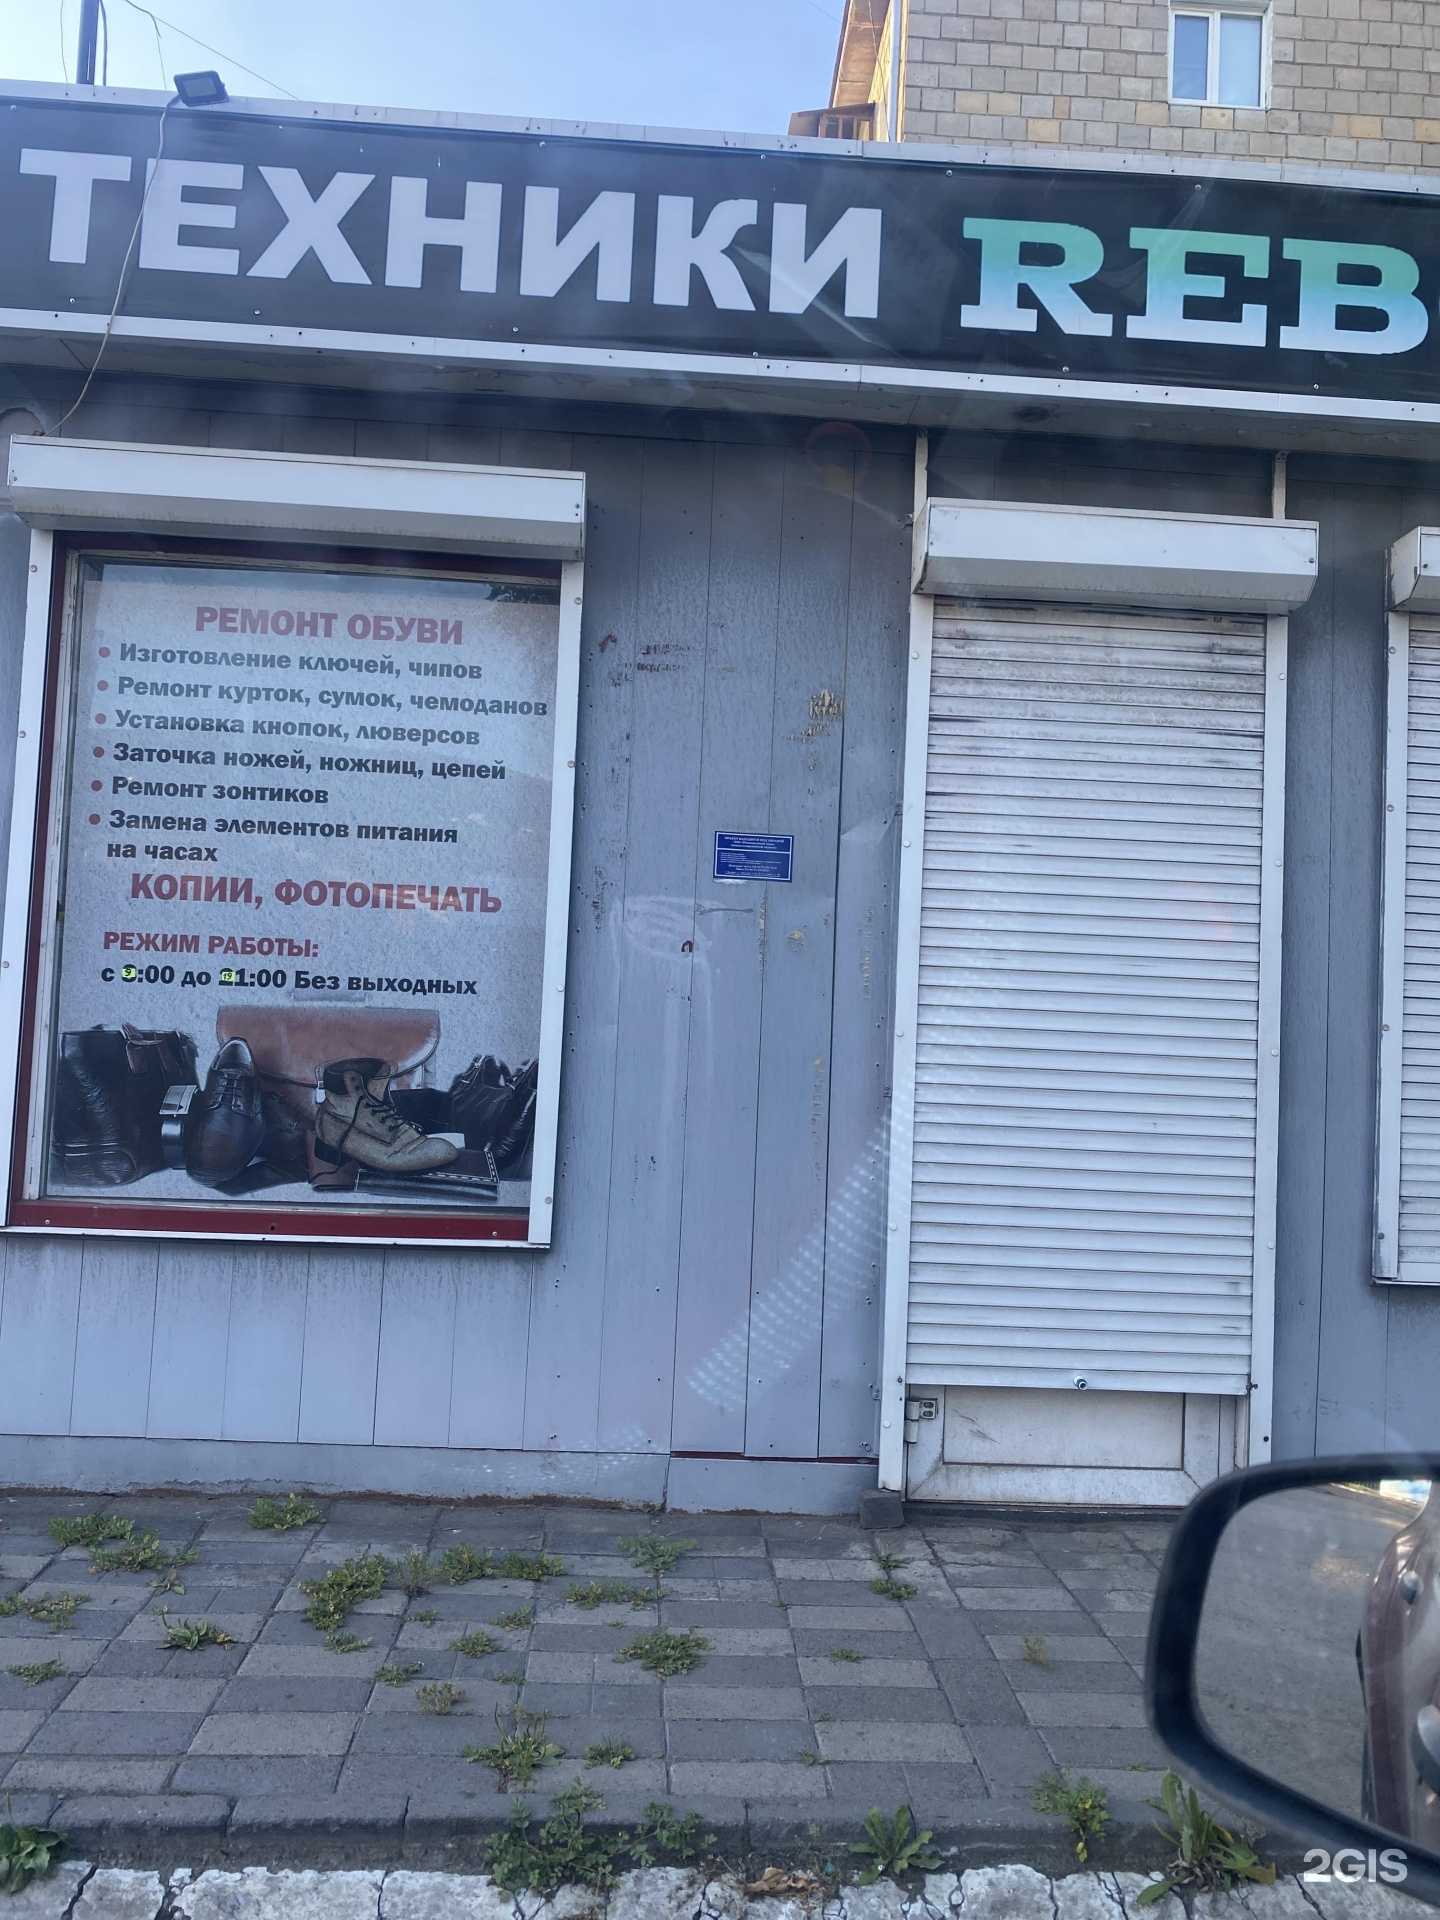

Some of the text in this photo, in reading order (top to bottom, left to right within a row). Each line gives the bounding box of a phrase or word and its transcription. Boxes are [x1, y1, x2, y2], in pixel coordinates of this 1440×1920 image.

[19, 148, 883, 319] ТЕХНИКИ
[960, 217, 1440, 355] REB
[195, 606, 463, 645] РЕМОНТ ОБУВИ
[119, 643, 483, 680] Изготовление ключей, чипов
[118, 676, 548, 716] Ремонт курток, сумок, чемоданов
[115, 709, 480, 746] Установка кнопок, люверсов
[113, 743, 506, 781] Заточка ножей, ножниц, цепей
[111, 776, 329, 804] Ремонт зонтиков
[110, 810, 458, 844] Замена элементов питания
[107, 842, 218, 863] на часах
[131, 873, 502, 913] КОПИИ, ФОТОПЕЧАТЬ
[103, 931, 319, 959] РЕЖИМ РАБОТЫ:
[101, 967, 115, 982] с
[181, 971, 212, 988] до
[295, 970, 340, 990] Без
[347, 976, 478, 997] выходных
